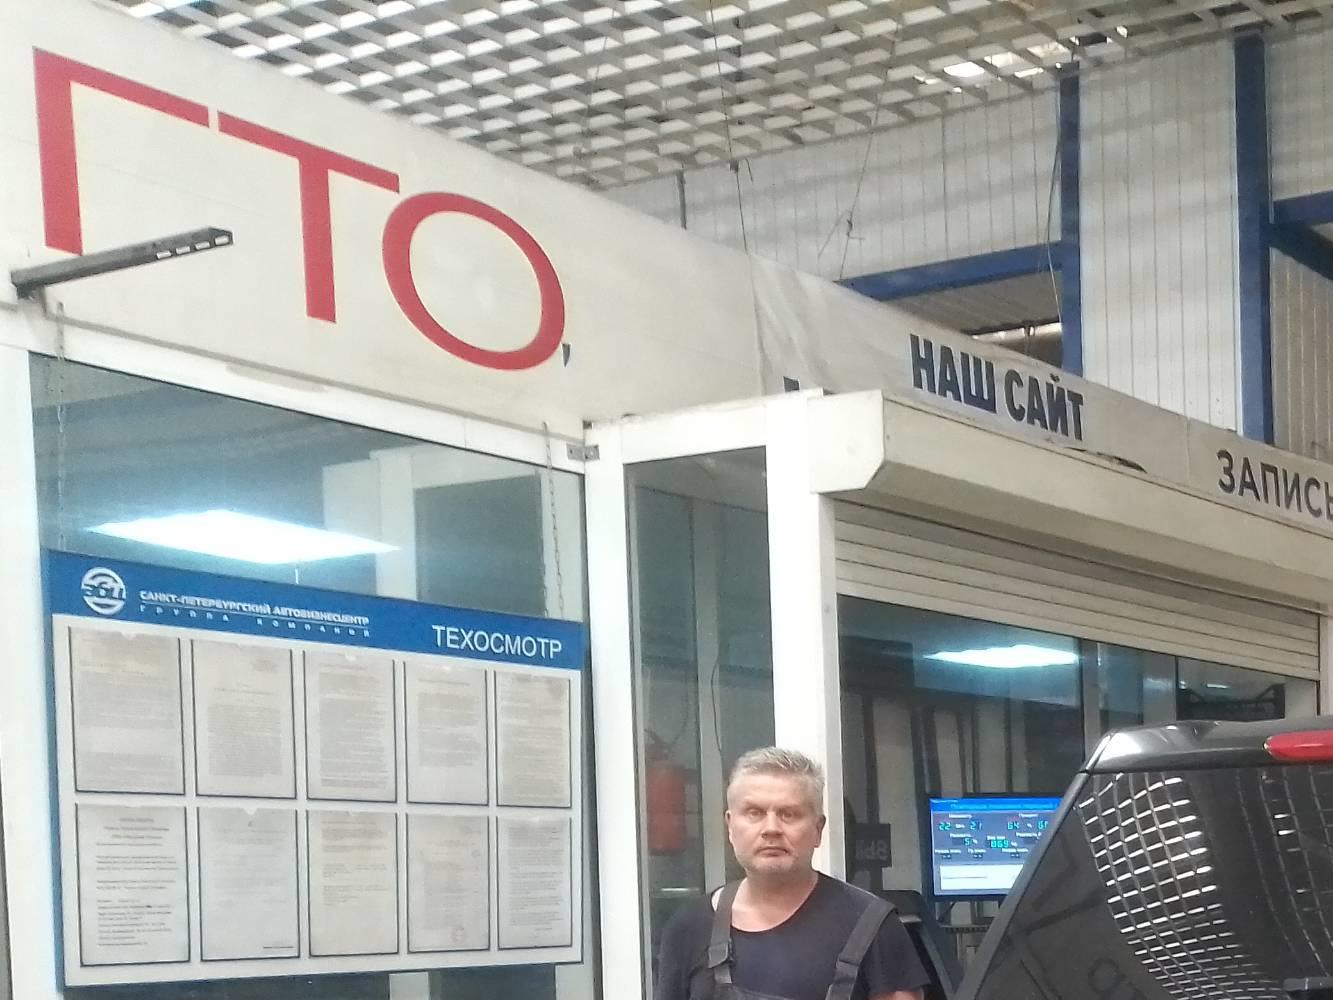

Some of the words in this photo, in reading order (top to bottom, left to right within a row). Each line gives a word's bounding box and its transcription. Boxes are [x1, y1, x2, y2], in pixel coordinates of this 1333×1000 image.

[909, 333, 997, 414] НАШ
[1004, 368, 1084, 441] САЙТ
[431, 624, 563, 659] ТЕХОСМОТР
